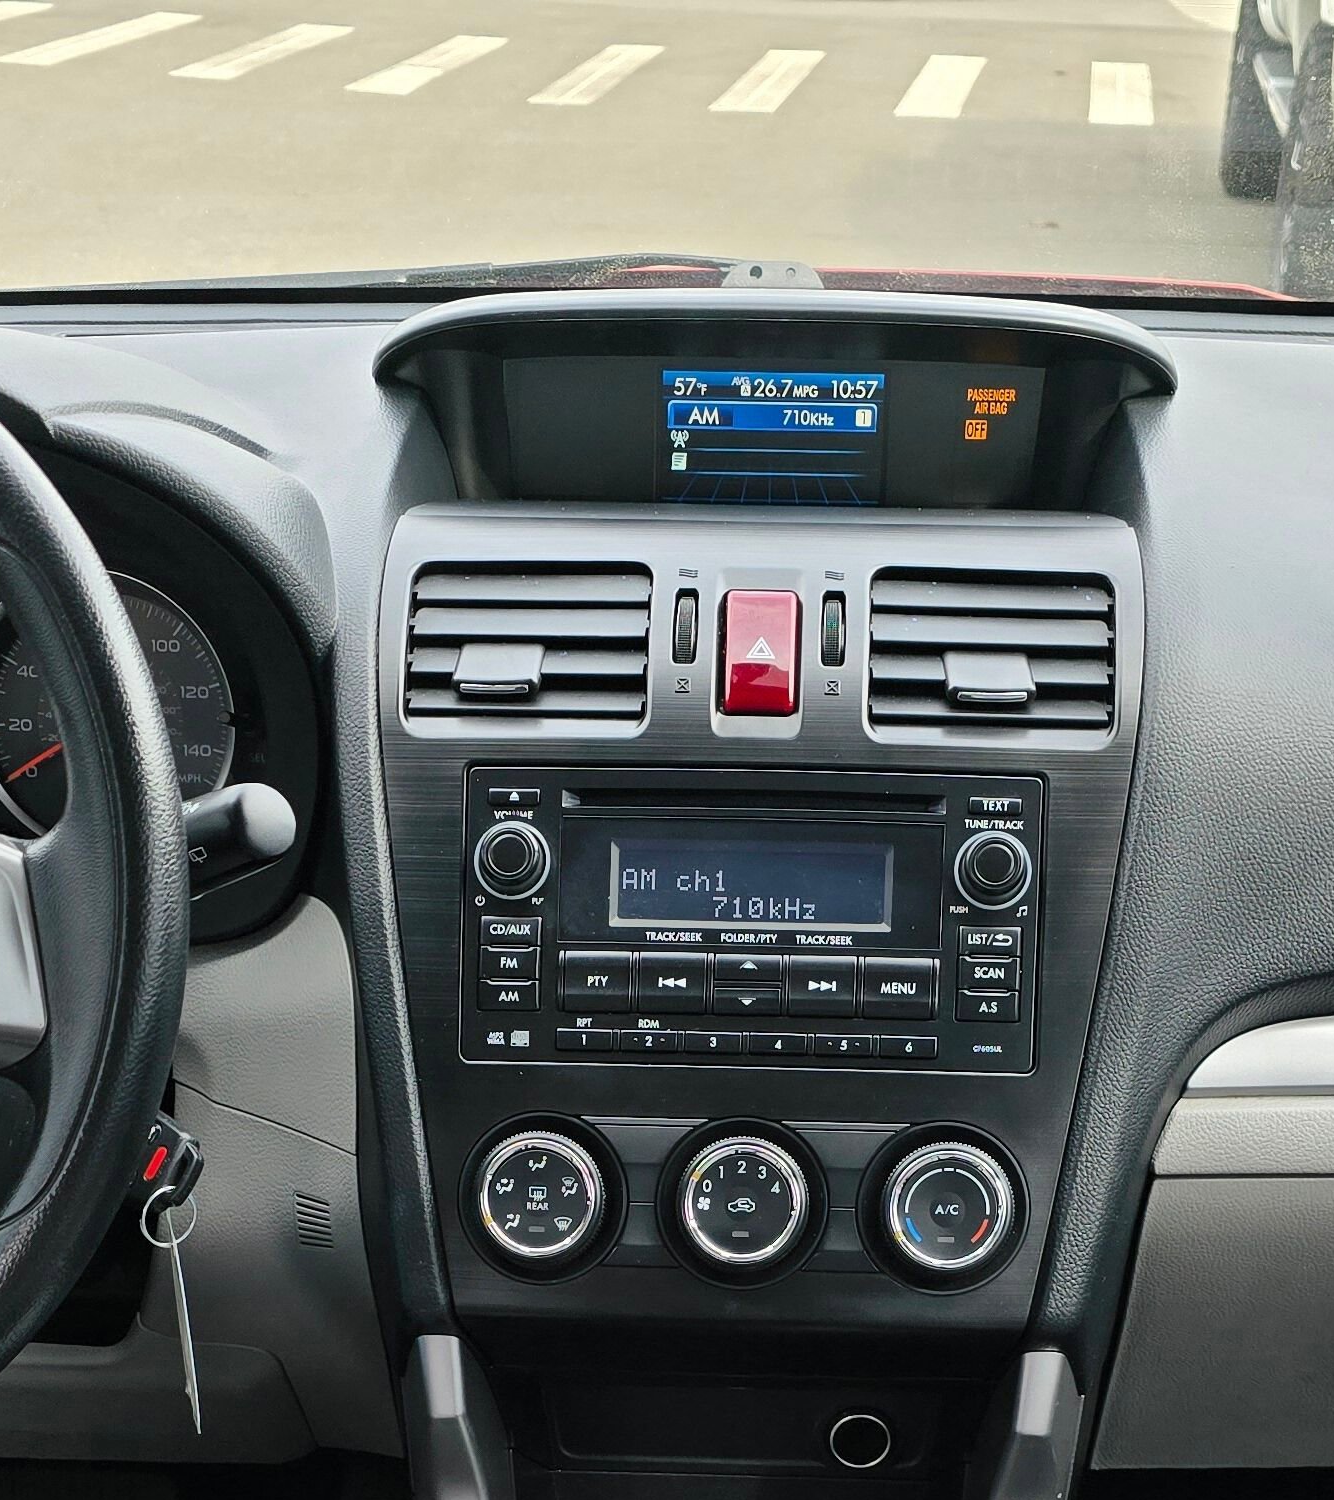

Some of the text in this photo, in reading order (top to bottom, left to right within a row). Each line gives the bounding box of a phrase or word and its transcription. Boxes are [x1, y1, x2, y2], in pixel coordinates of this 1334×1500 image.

[831, 380, 879, 399] 10:57
[967, 388, 1016, 402] PASSENGER
[974, 401, 1008, 415] AIR BAG
[688, 406, 720, 425] AM
[966, 420, 987, 439] OFF
[151, 638, 181, 653] 100
[180, 685, 210, 700] 120
[8, 718, 33, 732] 20
[183, 743, 212, 758] 140
[178, 773, 202, 784] MPH
[982, 800, 1009, 812] TEXT
[964, 819, 1024, 830] TUNE/TRACK
[622, 868, 726, 892] AM ch1
[712, 896, 816, 920] 710kHz
[949, 905, 968, 914] PUSH
[489, 923, 531, 936] CD/AUX
[645, 931, 703, 943] TRACK/SEEK
[720, 933, 777, 944] FOLDER/PTY
[795, 934, 853, 945] TRACK/SEEK
[499, 957, 518, 969] FM
[973, 966, 1005, 979] SCAN
[587, 975, 608, 987] PTY
[880, 982, 917, 995] MENU
[498, 991, 519, 1002] AM
[576, 1018, 592, 1028] RPT
[638, 1018, 660, 1029] RDM
[581, 1034, 587, 1046] 1
[645, 1036, 653, 1047] 2
[709, 1037, 717, 1048] 3
[774, 1039, 782, 1050] 4
[839, 1040, 847, 1051] 5
[905, 1041, 913, 1053] 6
[719, 1165, 725, 1179] 1
[736, 1161, 747, 1175] 2
[757, 1165, 768, 1180] 3
[702, 1180, 713, 1193] 0
[770, 1181, 781, 1195] 4
[525, 1201, 550, 1211] REAR
[935, 1203, 960, 1216] A/C
